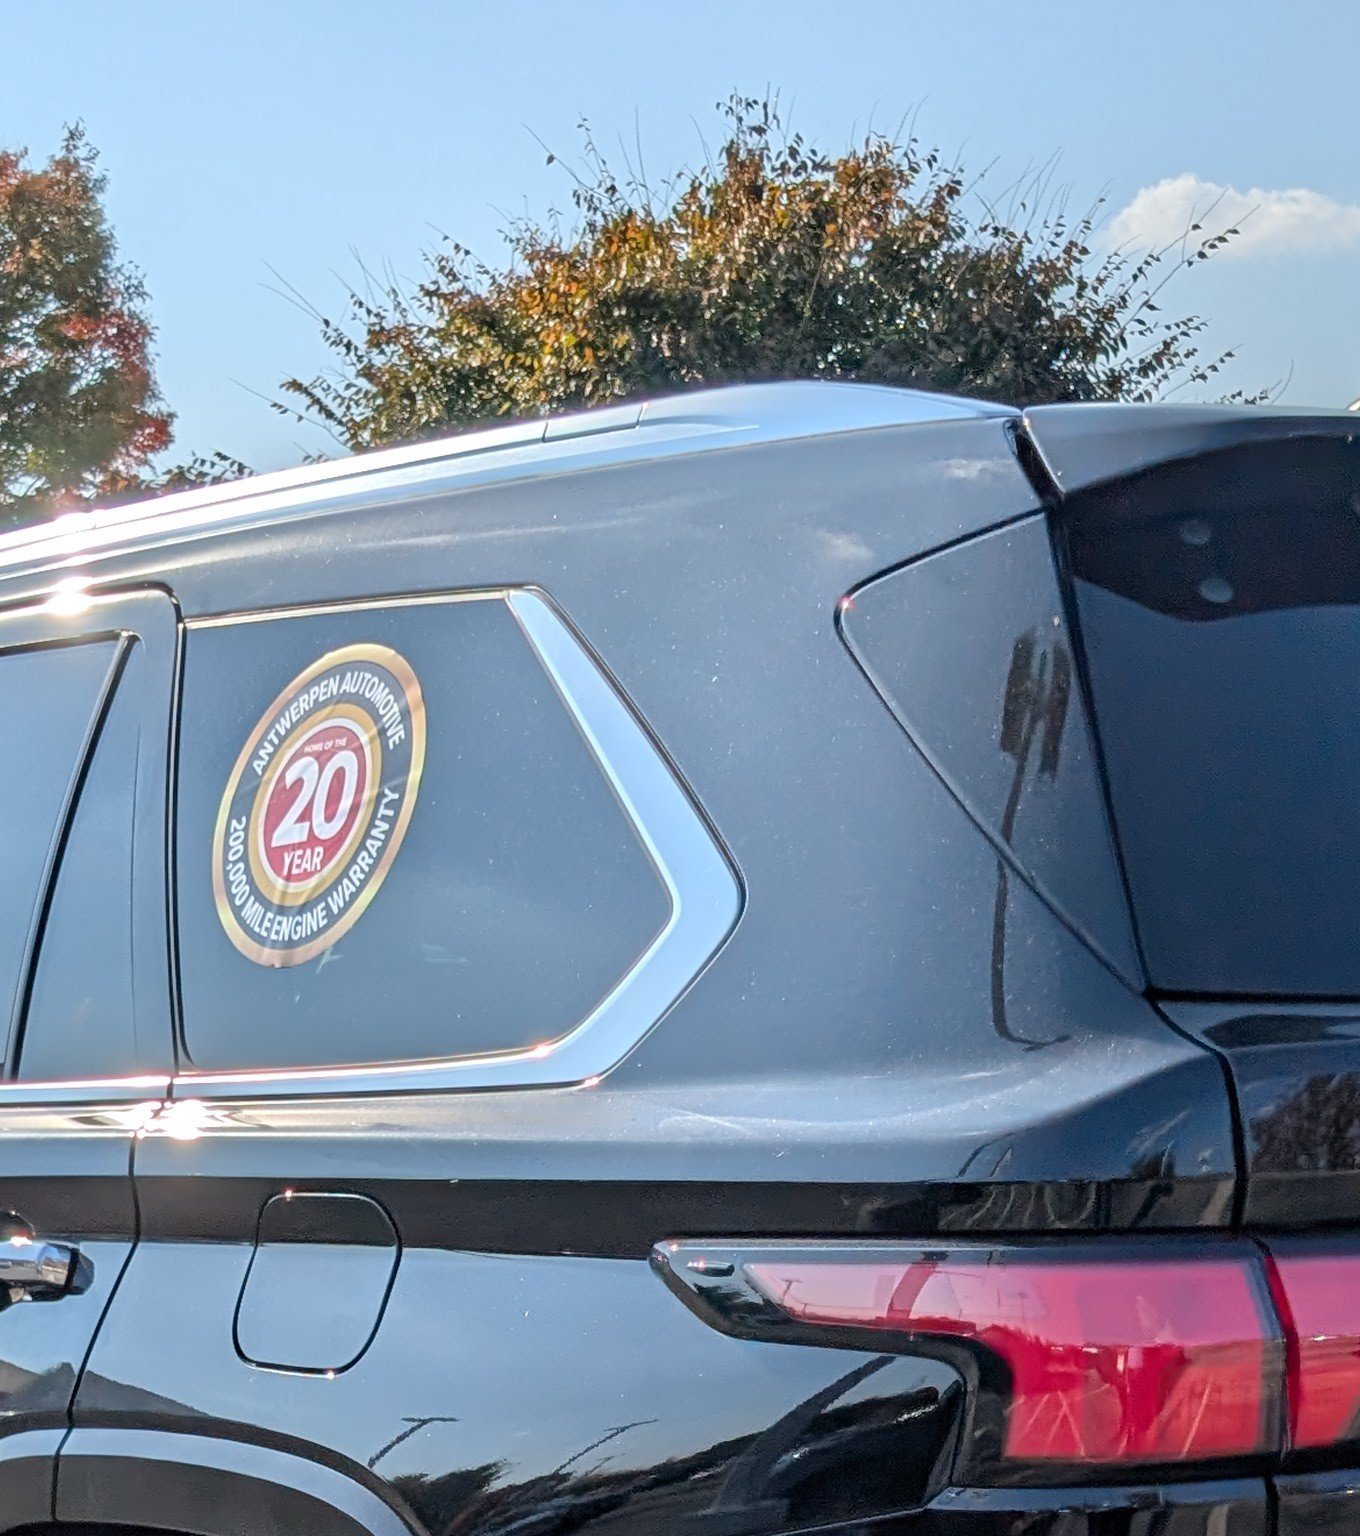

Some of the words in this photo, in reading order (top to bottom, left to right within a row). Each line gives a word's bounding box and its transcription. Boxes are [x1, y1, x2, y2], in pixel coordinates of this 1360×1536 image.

[252, 674, 340, 776] ANTWERPEN
[341, 670, 406, 751] AUTOMOTIVE
[271, 749, 358, 848] 20
[228, 816, 250, 906] 200,000
[241, 896, 271, 938] MILE
[271, 906, 328, 942] ENGINE
[327, 788, 399, 916] WARRANTY
[282, 846, 324, 877] YEAR
